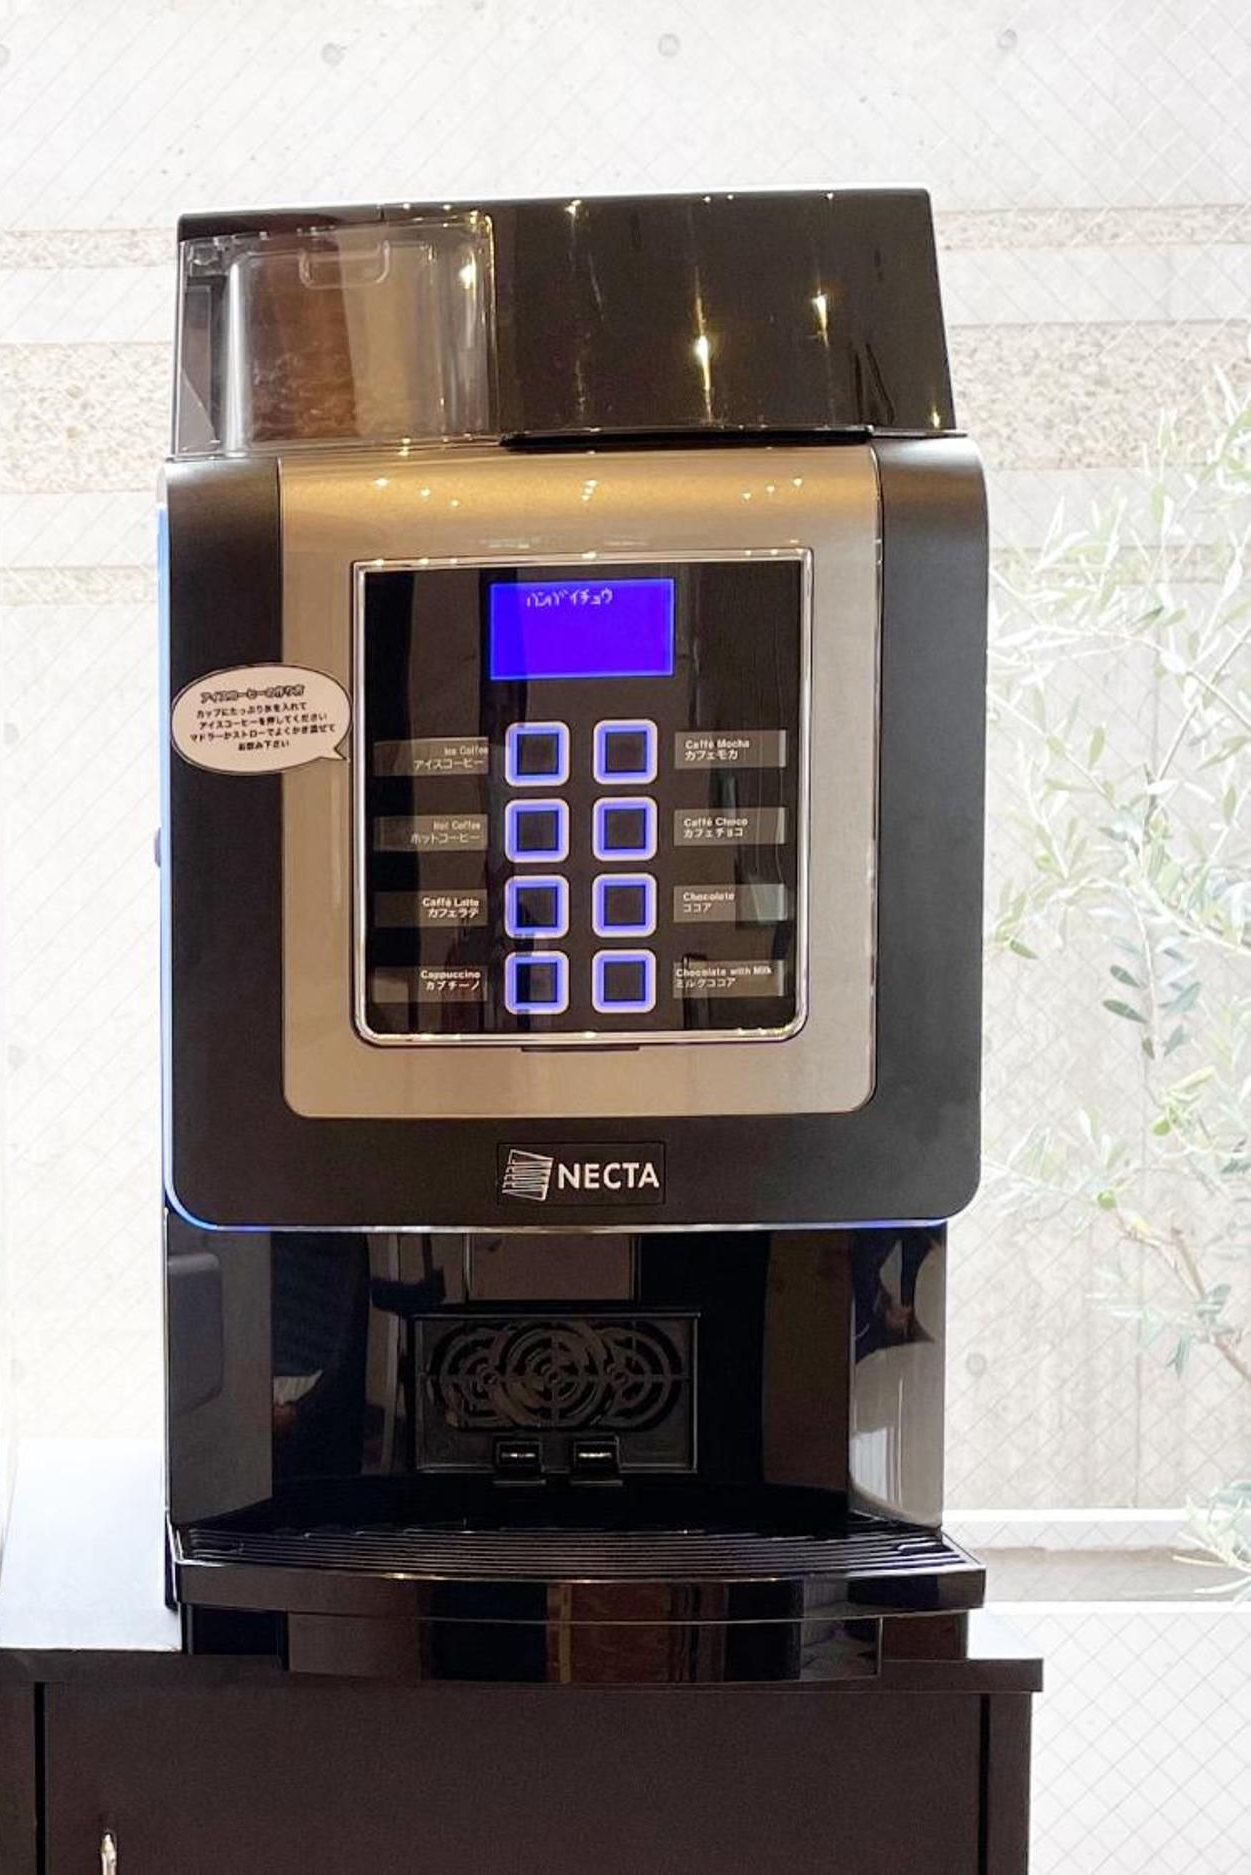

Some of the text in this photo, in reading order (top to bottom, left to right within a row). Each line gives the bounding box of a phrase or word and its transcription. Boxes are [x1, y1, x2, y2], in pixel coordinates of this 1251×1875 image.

[716, 738, 750, 749] Mocha
[684, 749, 739, 761] カフェモカ
[413, 758, 484, 771] アイスコーヒー
[451, 819, 481, 830] Coffee
[715, 817, 749, 827] Choco
[410, 832, 481, 845] ホットコーヒー
[683, 827, 744, 839] カフェチョコ
[454, 896, 480, 907] Latte
[683, 891, 735, 902] Chocolate
[428, 907, 479, 919] カフェラテ
[683, 902, 713, 914] ココア
[420, 970, 481, 980] Cappuccino
[676, 965, 772, 977] Chocolate with Milk
[426, 980, 480, 991] カプチーノ
[676, 977, 736, 989] ミルクココア
[557, 1162, 660, 1189] NECTA
